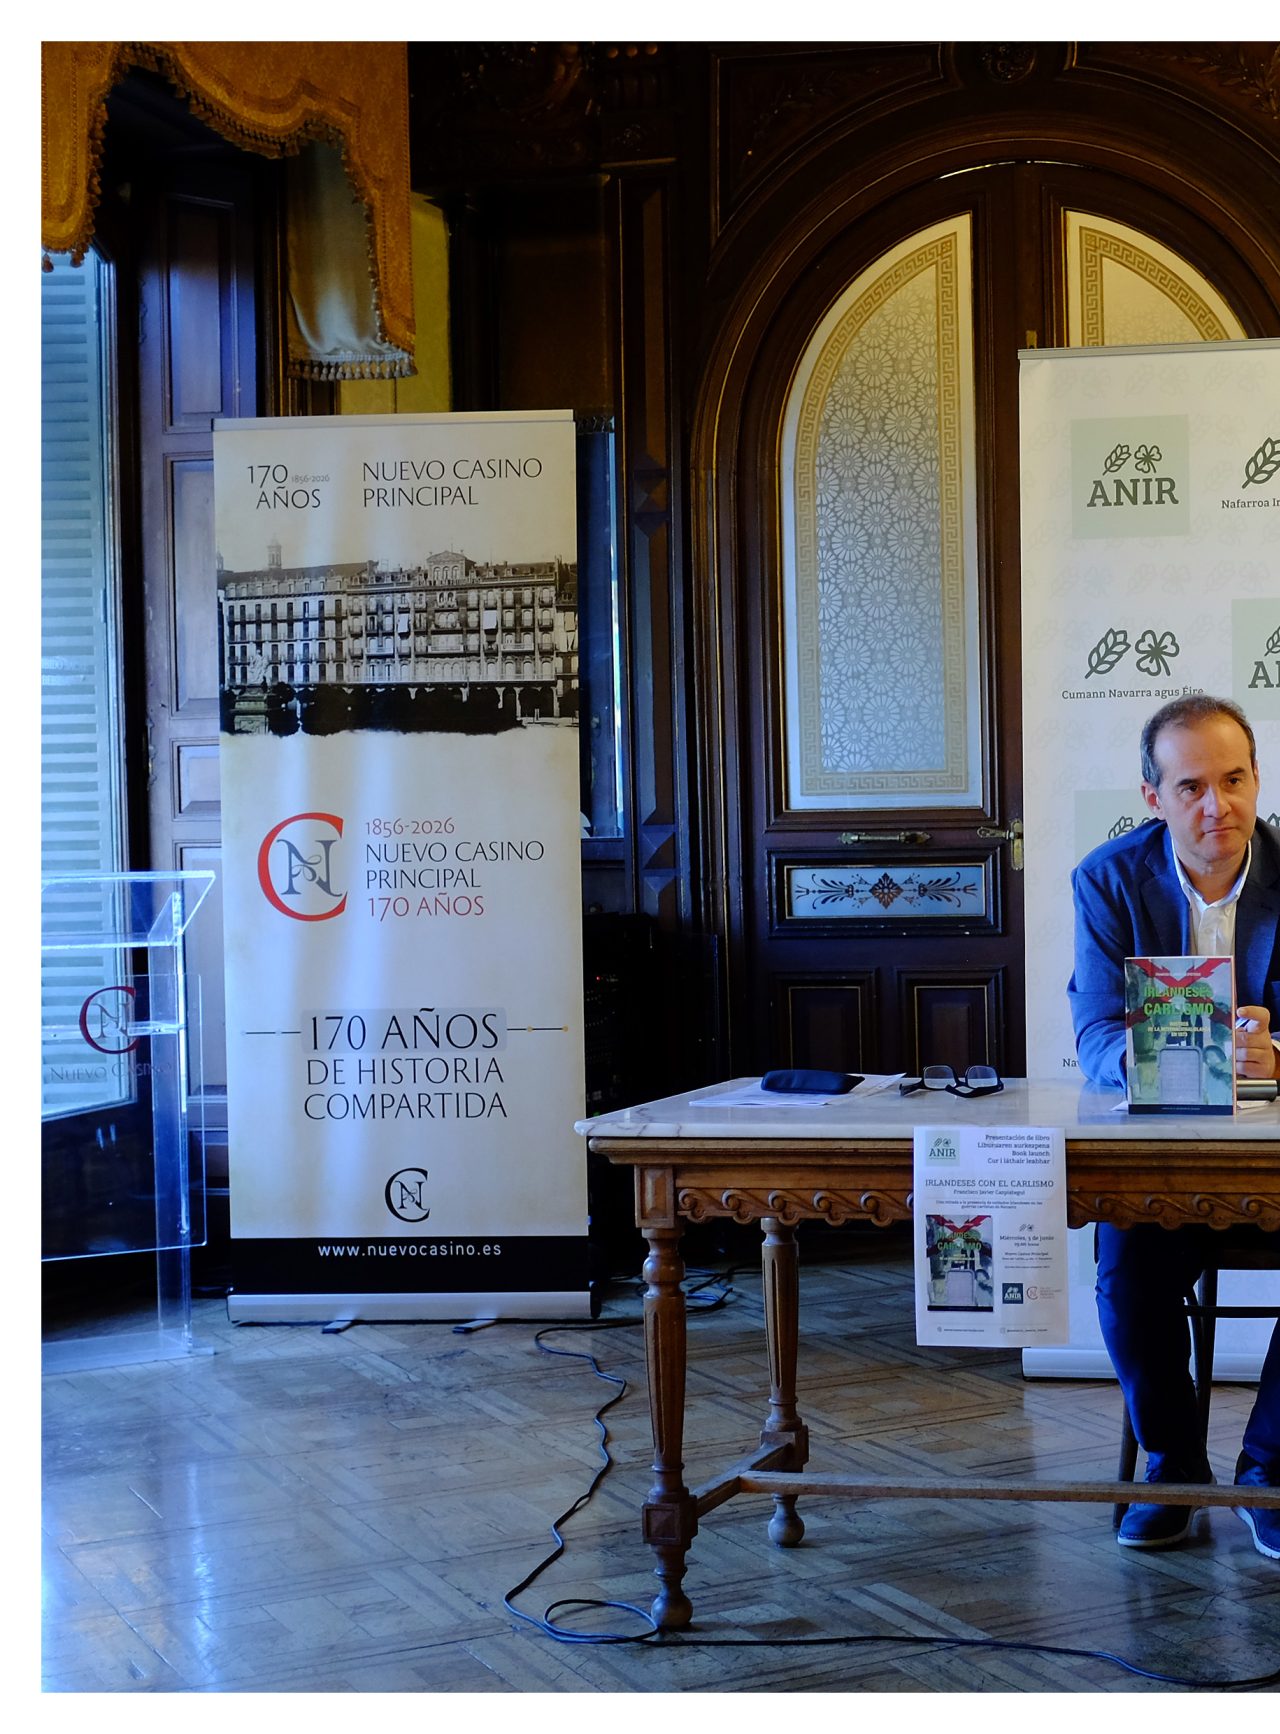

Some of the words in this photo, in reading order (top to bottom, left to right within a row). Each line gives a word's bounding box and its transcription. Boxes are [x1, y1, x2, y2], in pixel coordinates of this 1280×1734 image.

[247, 464, 289, 488] 170
[291, 474, 330, 484] 1856-2026
[362, 460, 445, 482] NUEVO
[452, 457, 543, 480] CASINO
[256, 483, 321, 510] AÑOS
[363, 486, 479, 508] PRINCIPAL
[1087, 478, 1179, 507] ANIR
[1221, 499, 1270, 509] Nafarroa
[1061, 690, 1106, 700] Cumann
[1108, 689, 1152, 698] Navarra
[1154, 688, 1179, 700] agus
[365, 818, 455, 837] 1856-2026
[365, 842, 447, 863] NUEVO
[455, 840, 546, 862] CASINO
[366, 867, 481, 889] PRINCIPAL
[368, 895, 409, 918] 170
[417, 891, 485, 917] AÑOS
[311, 1014, 367, 1050] 170
[381, 1007, 500, 1050] AÑOS
[307, 1058, 345, 1086] DE
[358, 1056, 505, 1084] HISTORIA
[303, 1091, 508, 1120] COMPARTIDA
[929, 1149, 957, 1157] ANIR
[925, 1179, 977, 1187] IRLANDESES
[978, 1179, 997, 1187] CON
[1010, 1180, 1054, 1188] CARLISMO
[318, 1241, 502, 1258] www.nuevocasino.es
